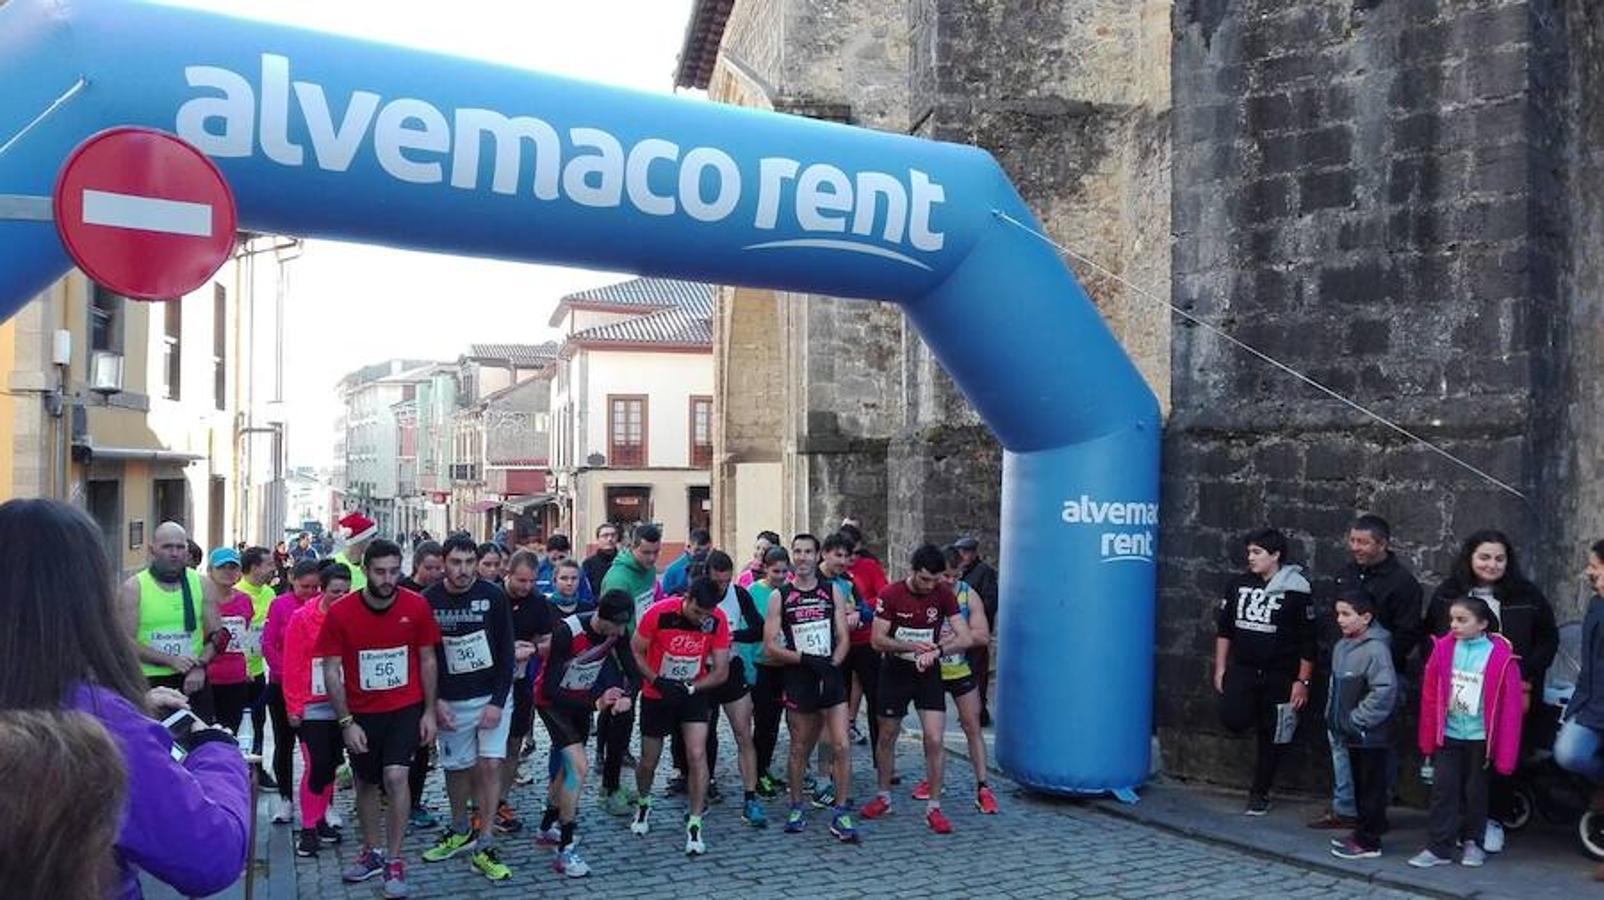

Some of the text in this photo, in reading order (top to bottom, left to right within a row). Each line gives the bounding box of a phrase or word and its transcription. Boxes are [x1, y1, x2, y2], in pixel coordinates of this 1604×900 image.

[176, 52, 946, 252] alvemaco rent
[1101, 530, 1153, 556] rent
[1236, 586, 1286, 624] T&F
[807, 633, 822, 648] 51
[163, 642, 181, 657] 99
[457, 647, 475, 661] 36
[375, 662, 395, 677] 56
